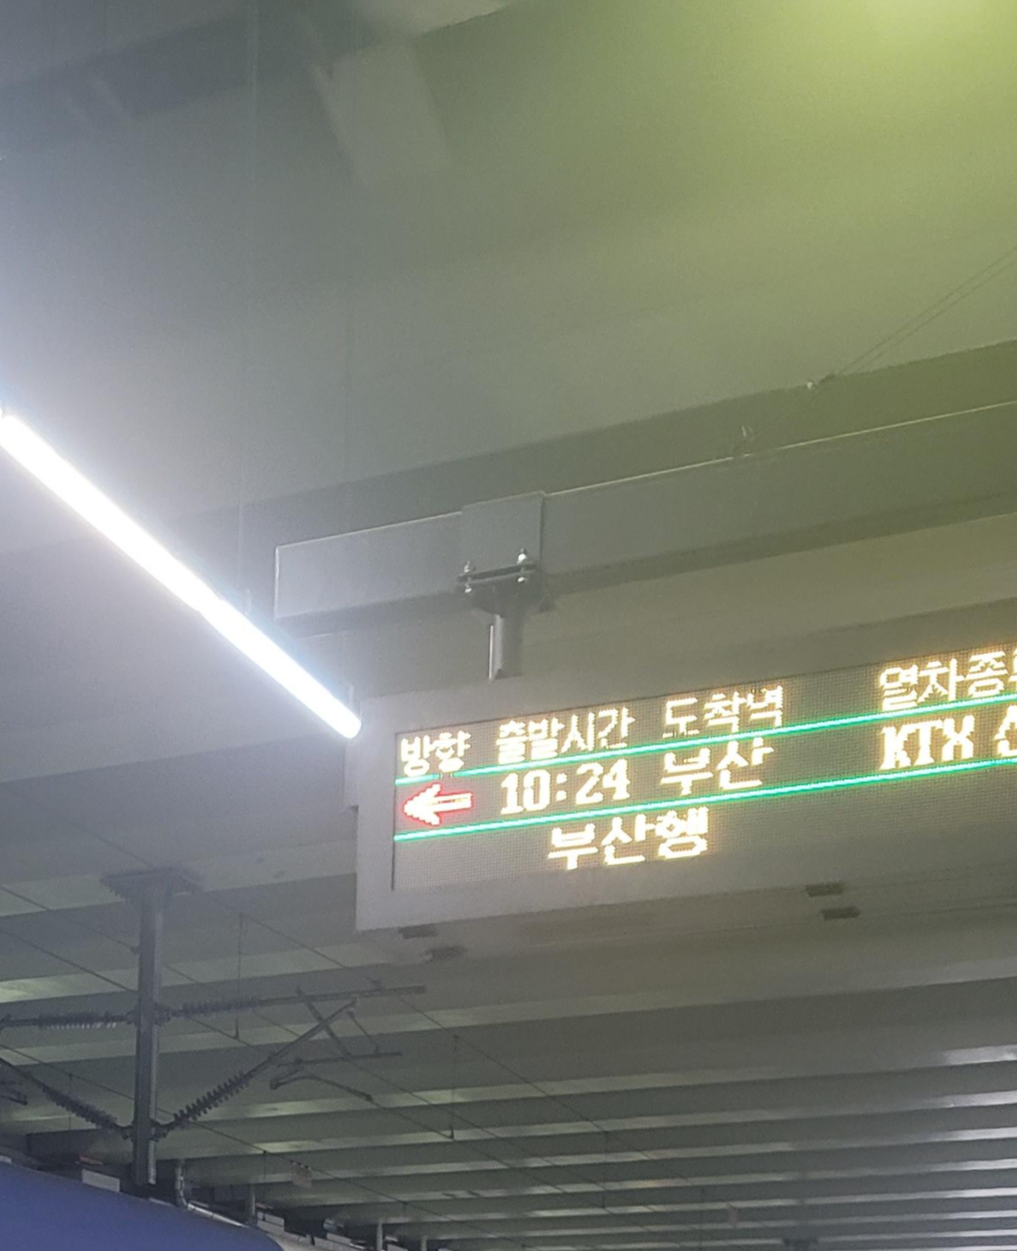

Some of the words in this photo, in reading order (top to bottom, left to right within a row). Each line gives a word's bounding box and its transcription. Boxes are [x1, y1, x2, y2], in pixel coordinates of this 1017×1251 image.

[400, 730, 471, 777] 방향
[496, 706, 636, 765] 출발시간
[500, 758, 631, 815] 10:24
[660, 736, 774, 796] 부산
[879, 714, 975, 771] KTX
[548, 806, 709, 870] 부산행
